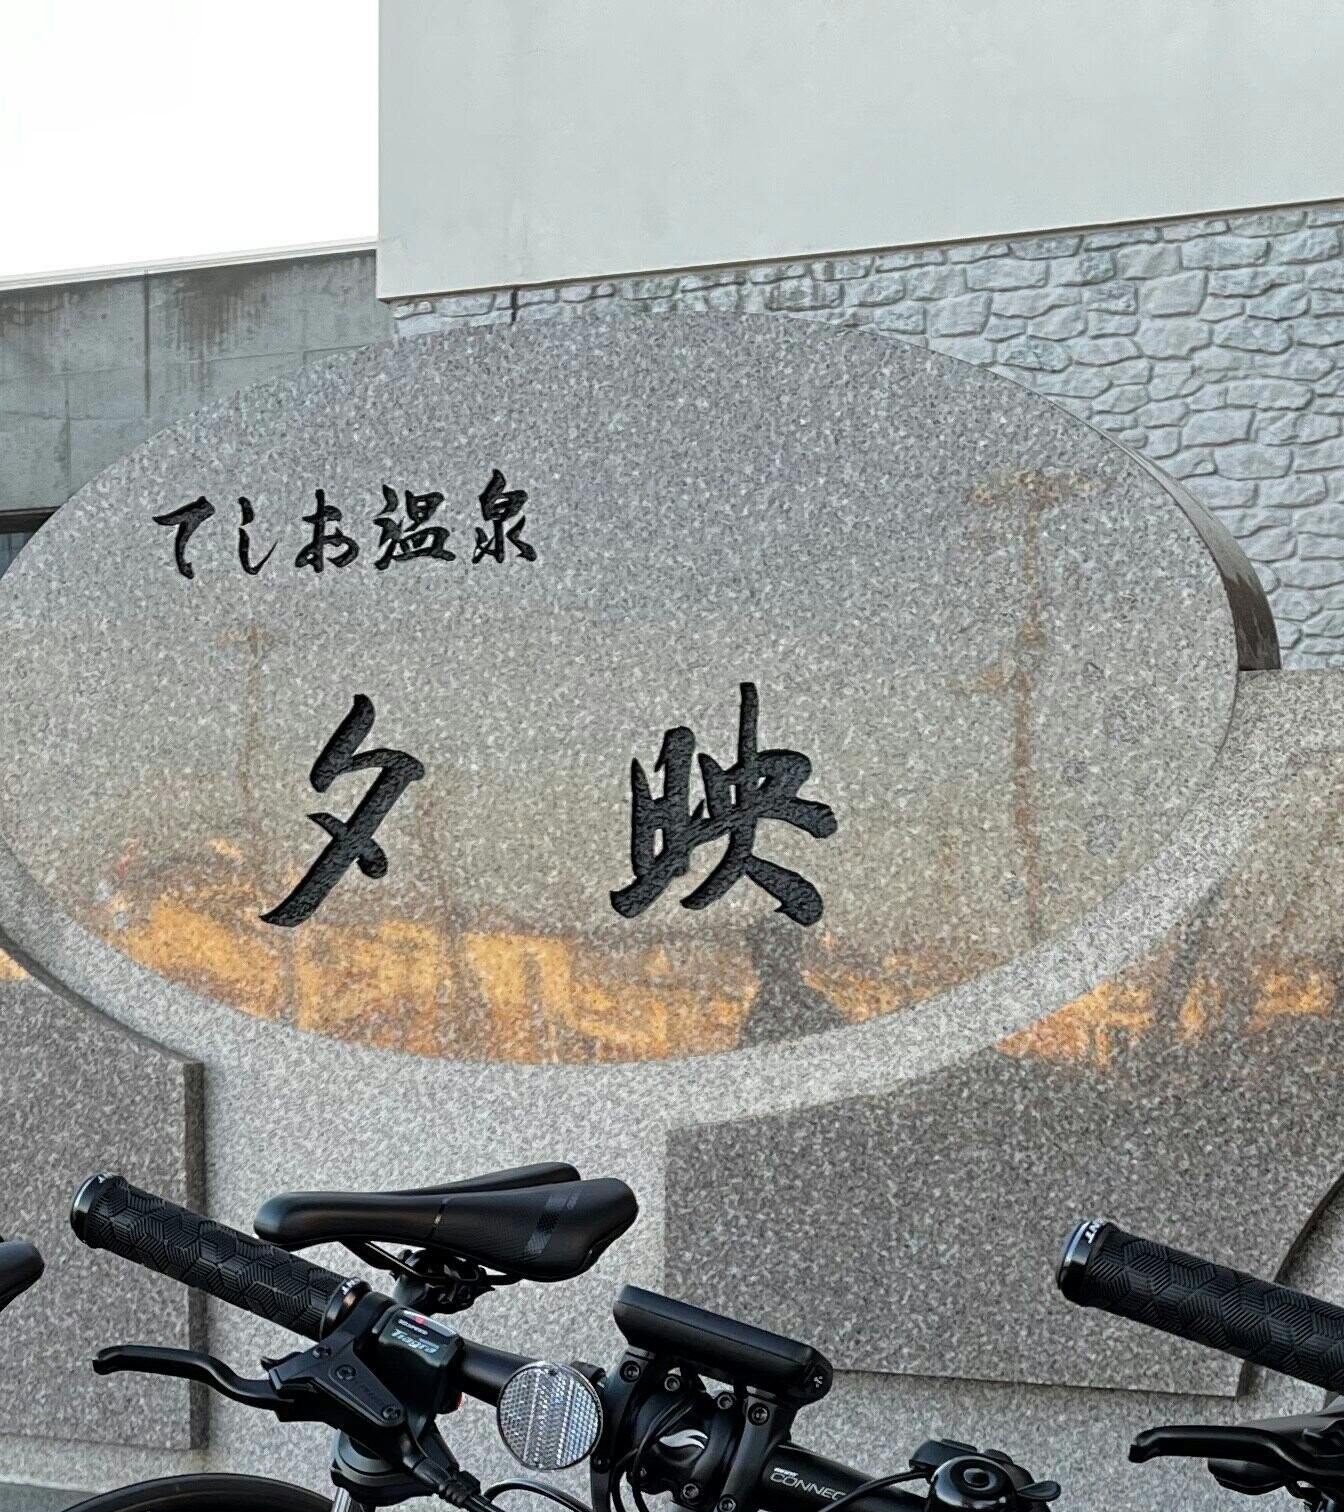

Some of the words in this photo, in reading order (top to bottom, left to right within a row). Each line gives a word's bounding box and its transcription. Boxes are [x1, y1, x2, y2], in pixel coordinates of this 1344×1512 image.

[151, 468, 538, 580] てしお温泉
[258, 681, 838, 927] 夕映
[769, 1471, 847, 1500] CONNEC
